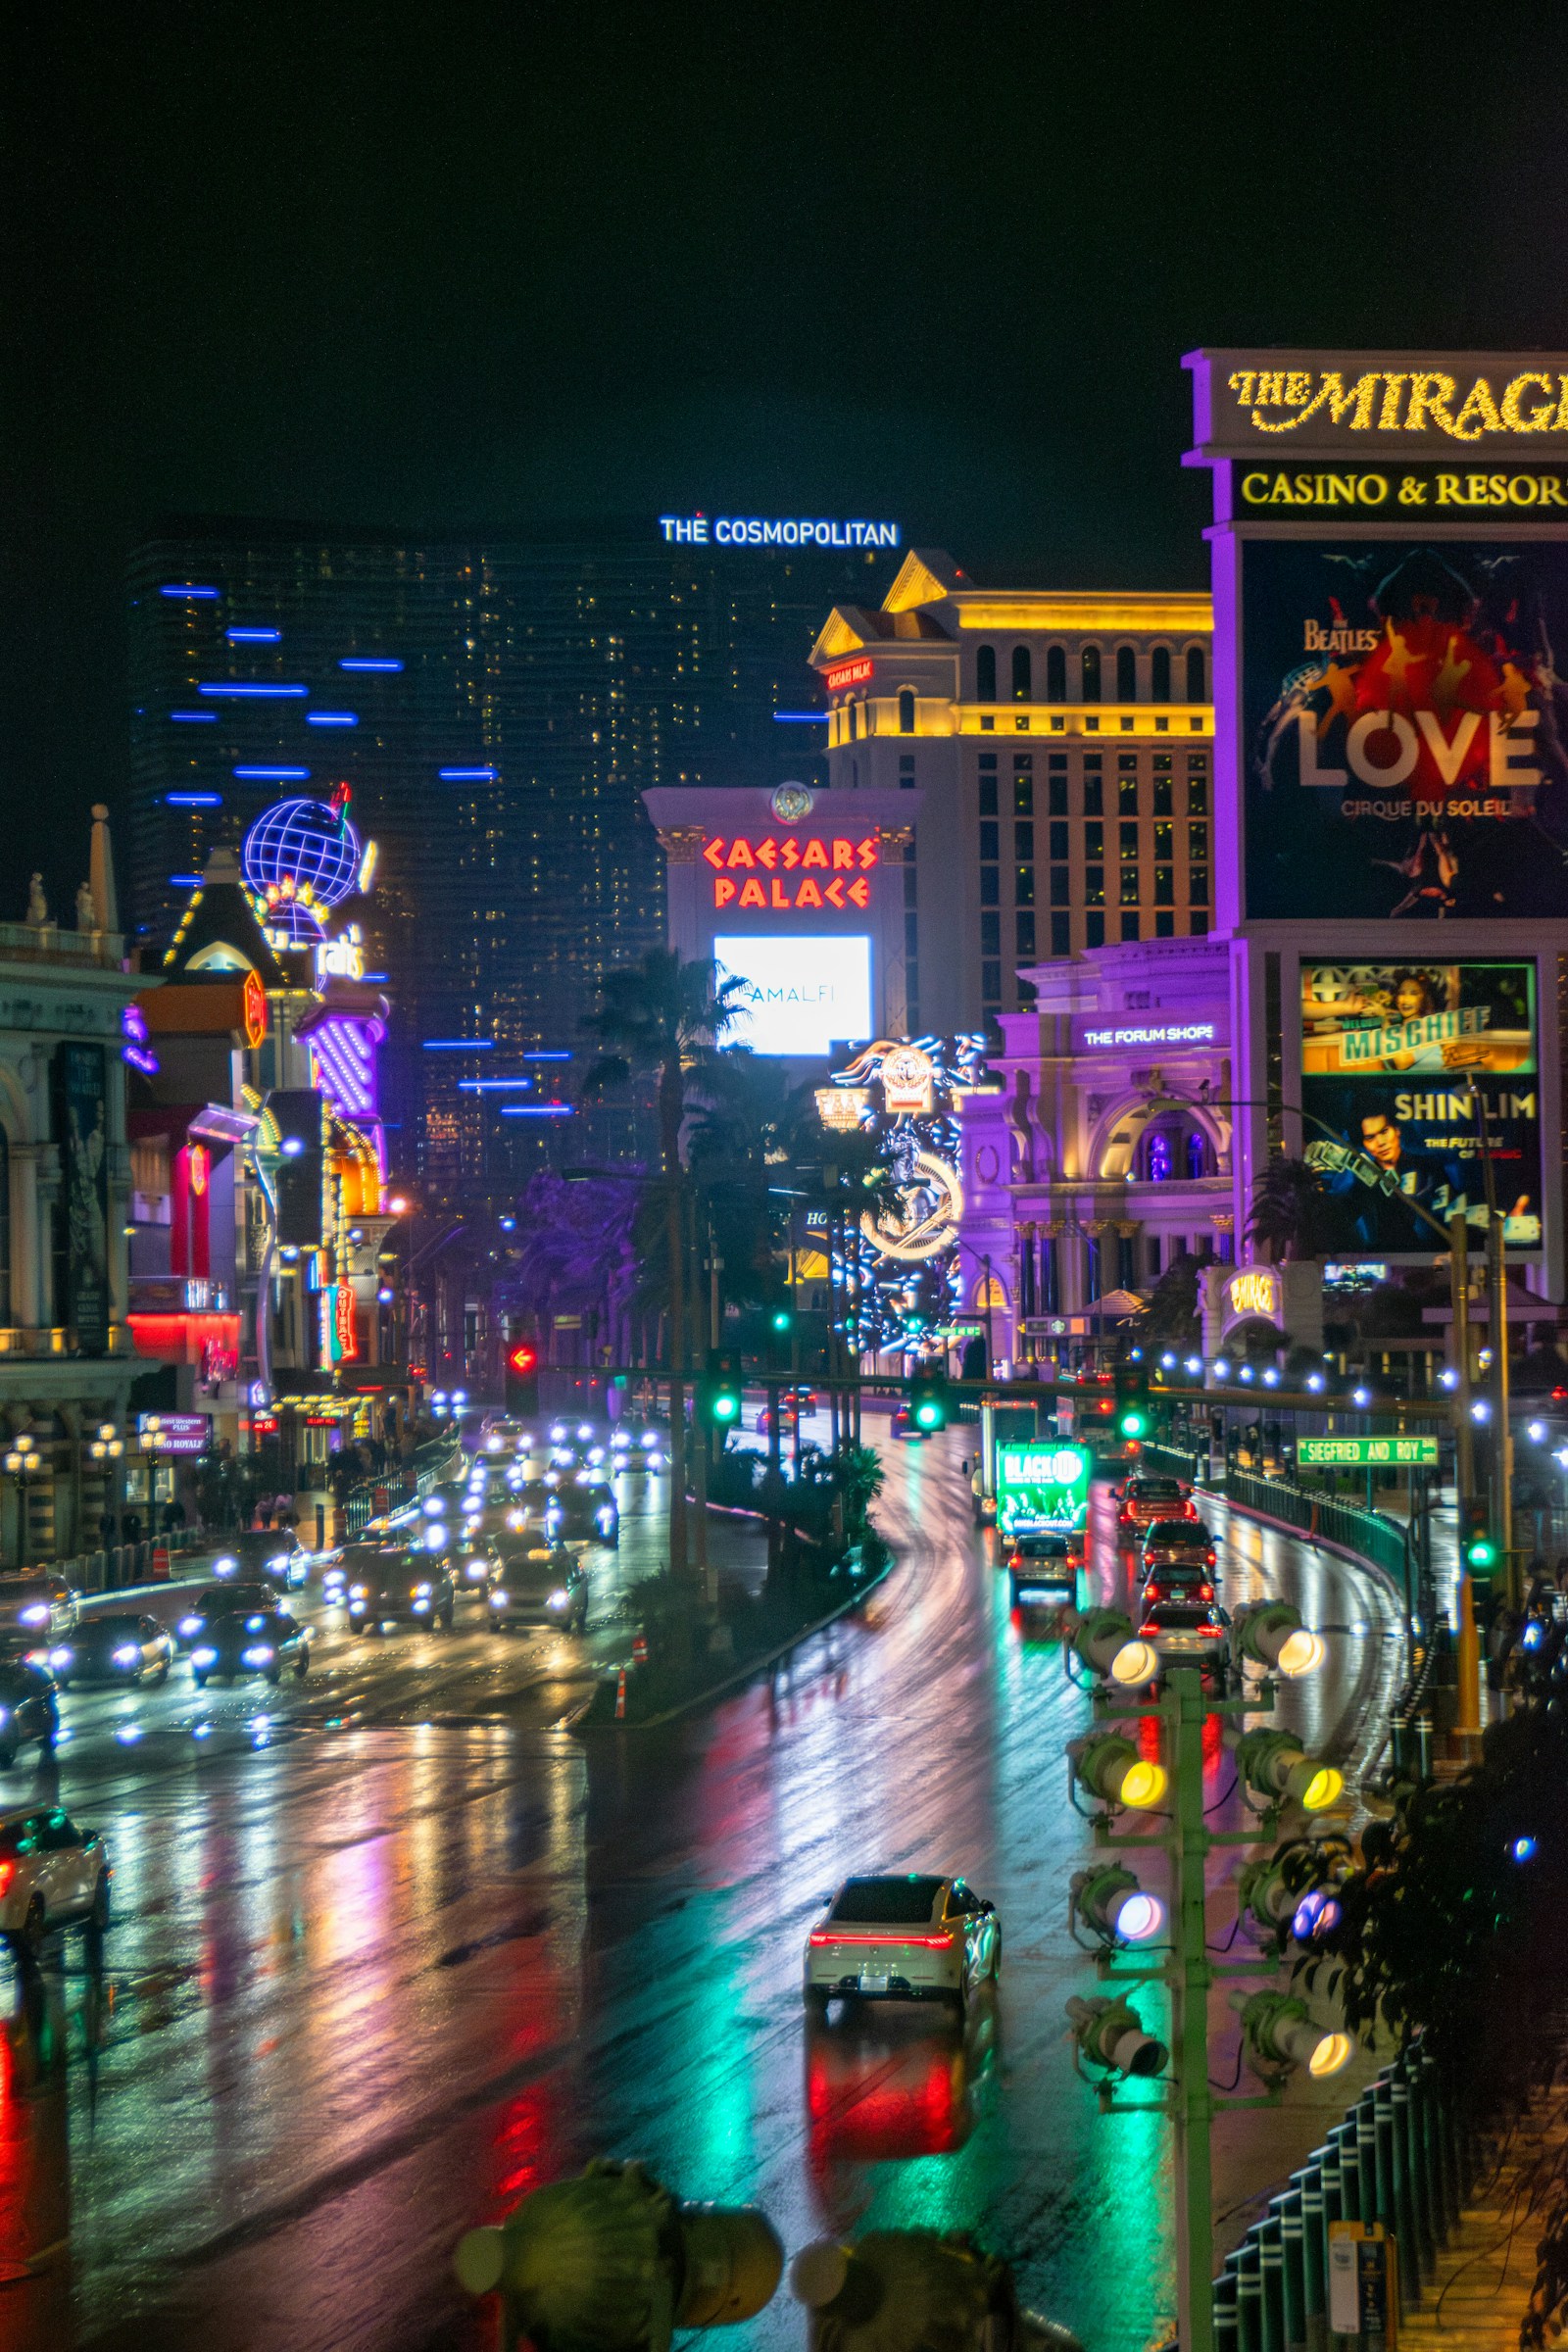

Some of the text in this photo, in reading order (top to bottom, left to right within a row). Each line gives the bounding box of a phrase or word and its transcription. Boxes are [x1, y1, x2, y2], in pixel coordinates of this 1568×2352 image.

[1228, 371, 1311, 406] THE
[1241, 473, 1568, 506] CASINO & RESOR
[662, 518, 897, 546] THE COSMOPOLITAN
[1303, 618, 1380, 654] BEATLES
[1298, 710, 1543, 787] LOVE
[1341, 801, 1512, 821] CIRQUE DU SOLEIL
[703, 838, 878, 869] CAESARS
[714, 877, 870, 907] PALACE
[744, 985, 835, 1003] AMALFI
[1084, 1025, 1213, 1046] THE FORUM SHOPS
[1345, 1006, 1491, 1061] MISCHIEF
[1395, 1092, 1536, 1121] SHIN LIM
[1424, 1139, 1448, 1148] THE
[337, 1290, 348, 1350] OUTBACK
[1308, 1442, 1360, 1461] SIEGFRIED
[1367, 1442, 1391, 1460] AND
[1396, 1442, 1419, 1460] ROY
